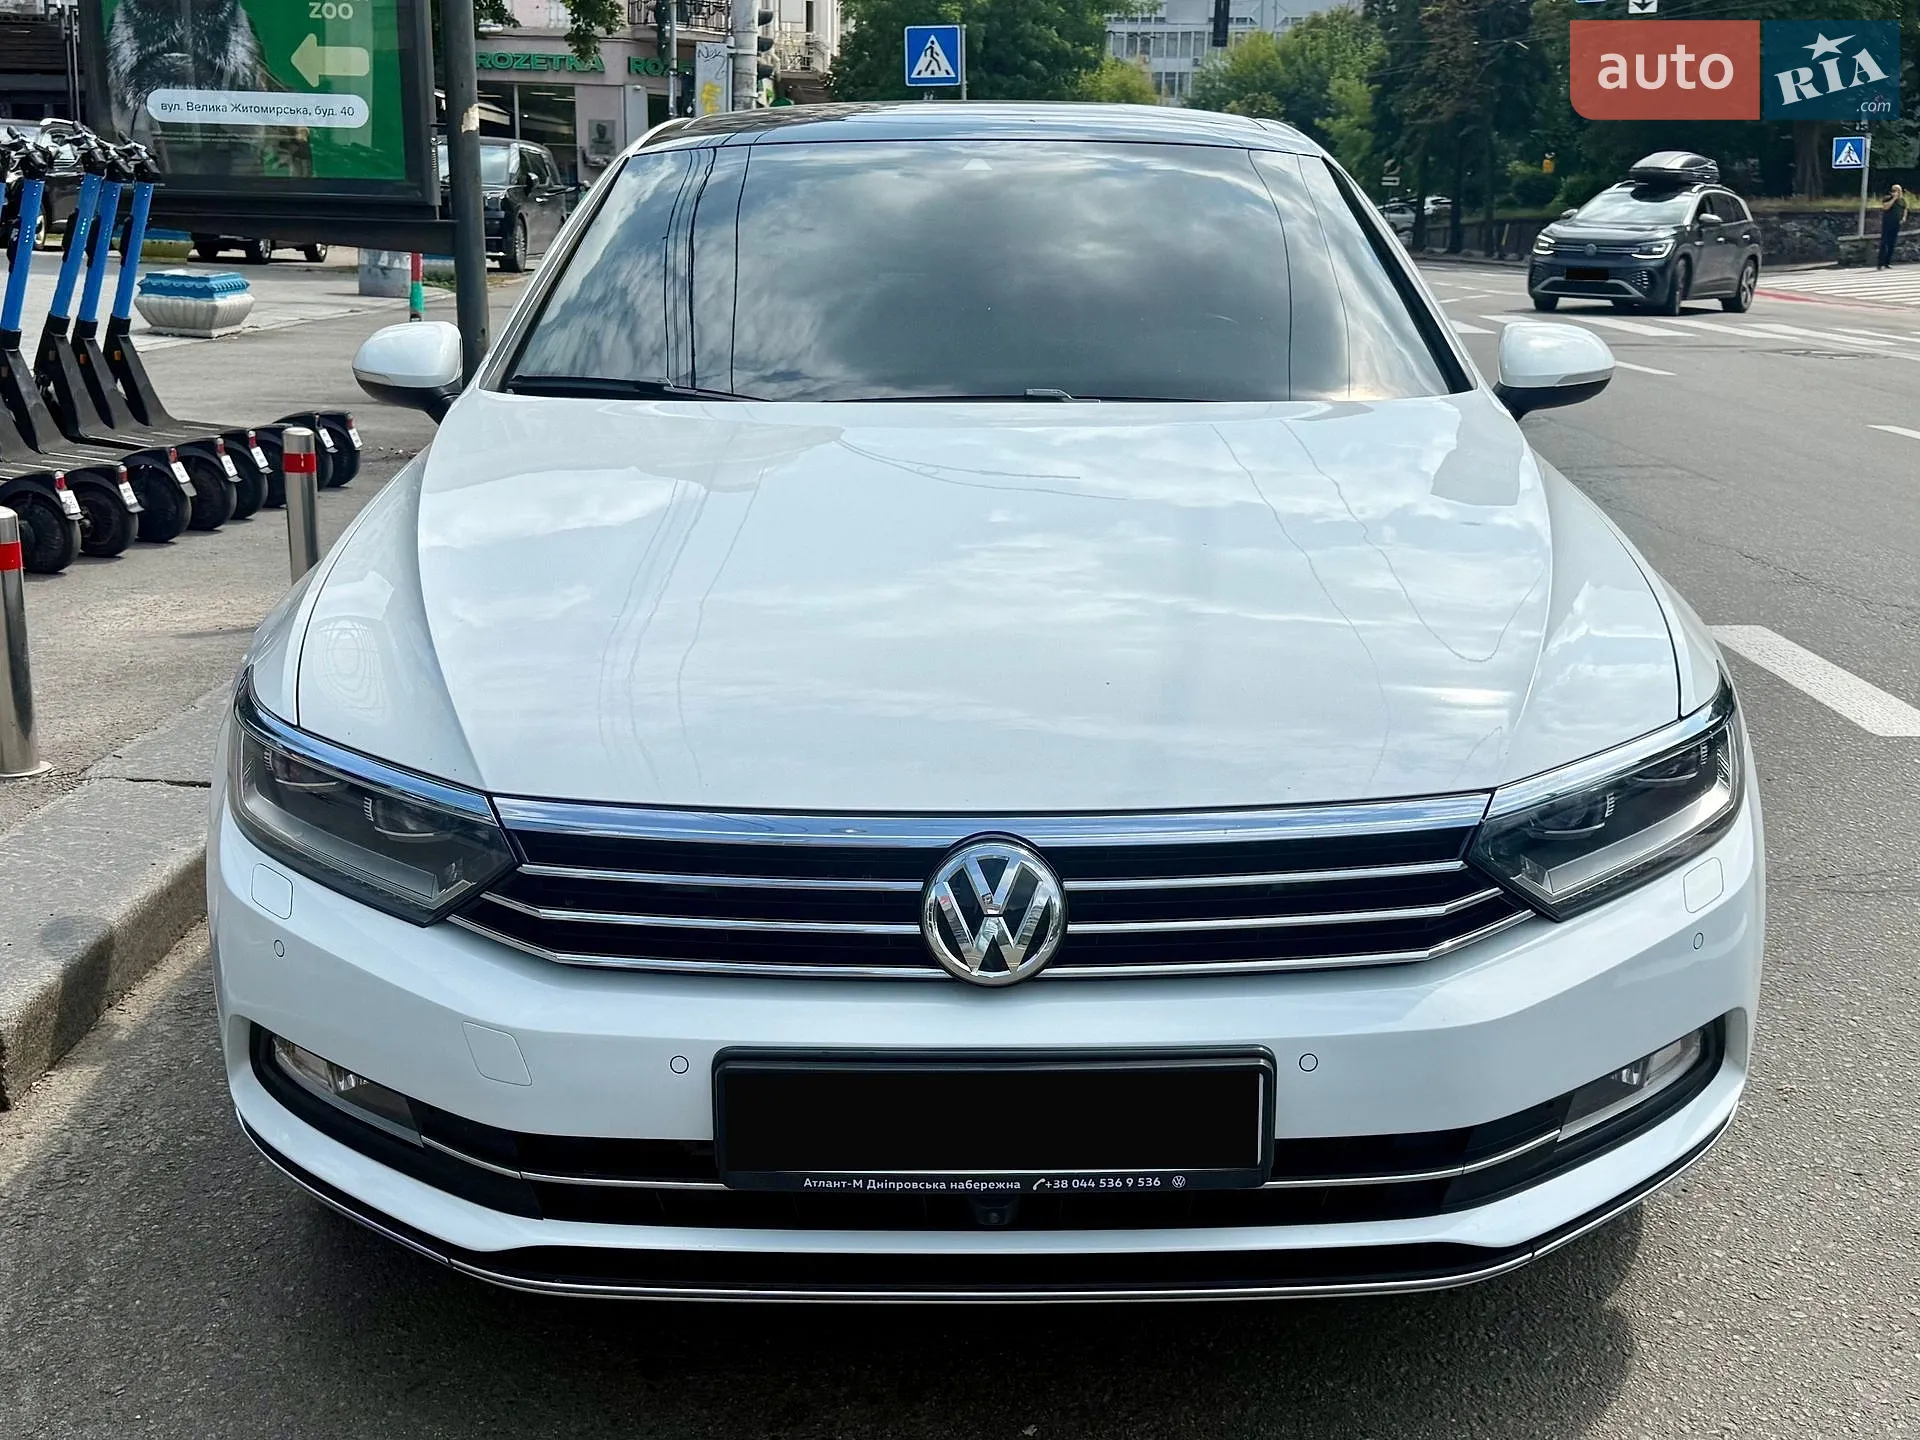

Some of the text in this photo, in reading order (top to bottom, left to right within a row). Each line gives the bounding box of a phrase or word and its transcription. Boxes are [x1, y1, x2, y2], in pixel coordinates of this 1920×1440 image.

[308, 2, 354, 19] ZOO
[476, 51, 605, 73] ROZETKA
[160, 101, 355, 118] вул. Велика Житомирська, буд. 40
[803, 1177, 864, 1189] Атлант-М
[866, 1178, 947, 1192] Дніпровська
[949, 1179, 1021, 1192] набережна
[1044, 1178, 1069, 1189] +38
[1071, 1178, 1096, 1189] 044
[1099, 1178, 1123, 1188] 536
[1125, 1177, 1134, 1188] 9
[1137, 1177, 1161, 1188] 536
